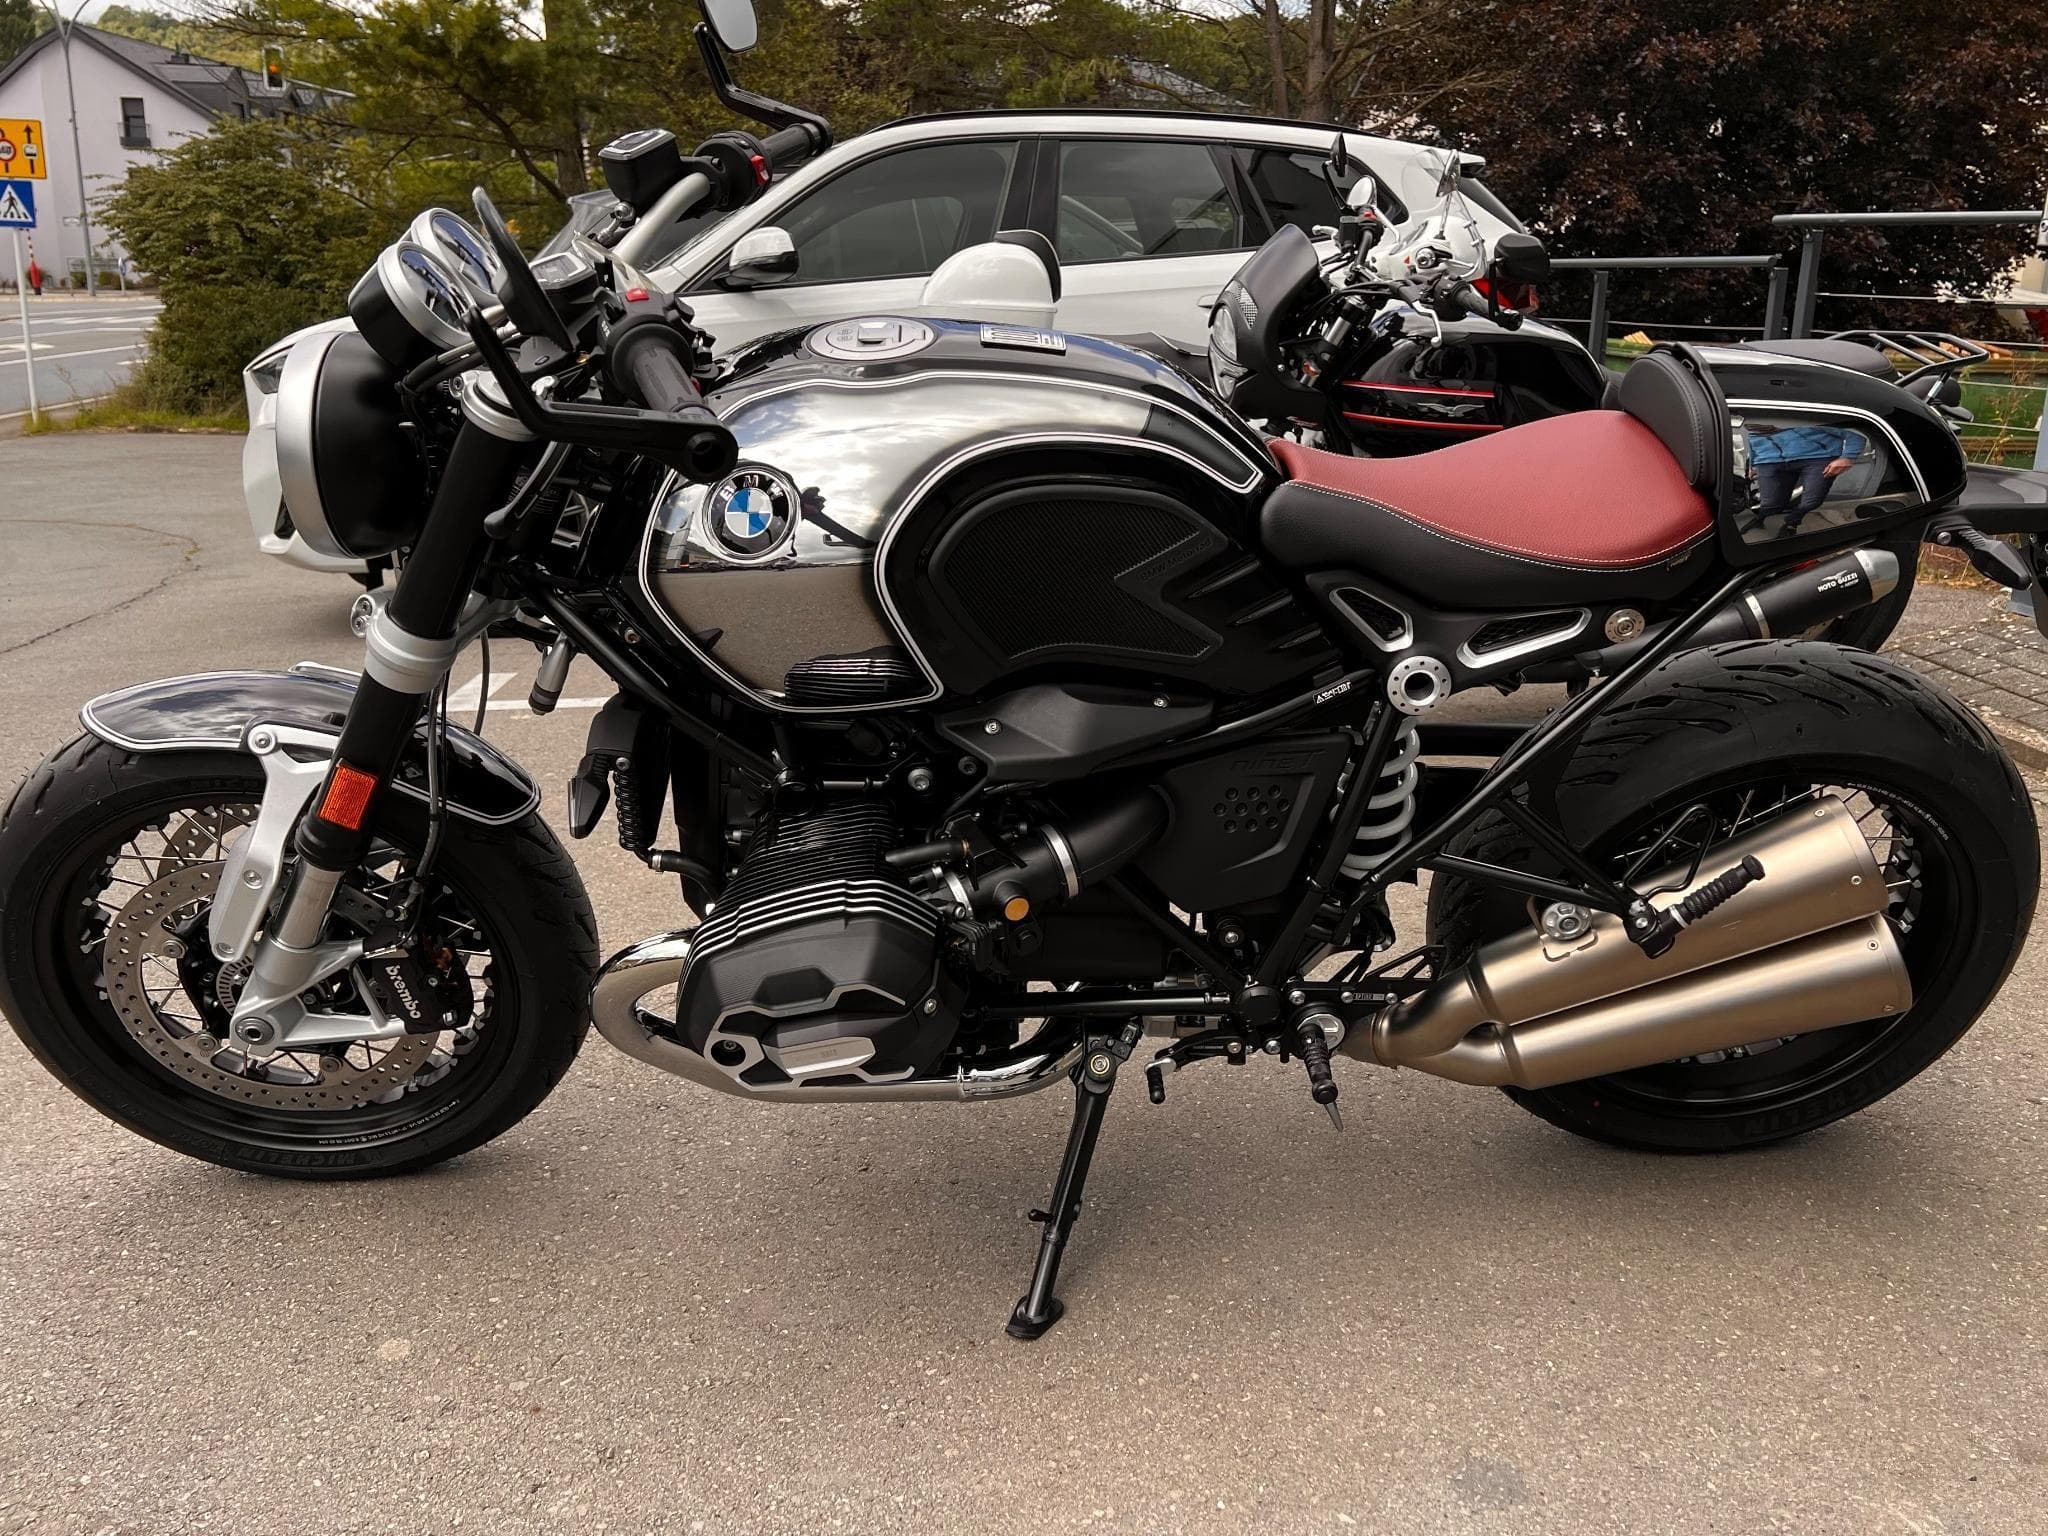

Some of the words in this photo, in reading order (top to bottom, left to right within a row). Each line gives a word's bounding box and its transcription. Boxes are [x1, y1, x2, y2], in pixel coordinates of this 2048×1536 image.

[1817, 580, 1837, 593] MOTO
[385, 965, 421, 1019] brembo
[236, 1149, 355, 1166] MICHELIN
